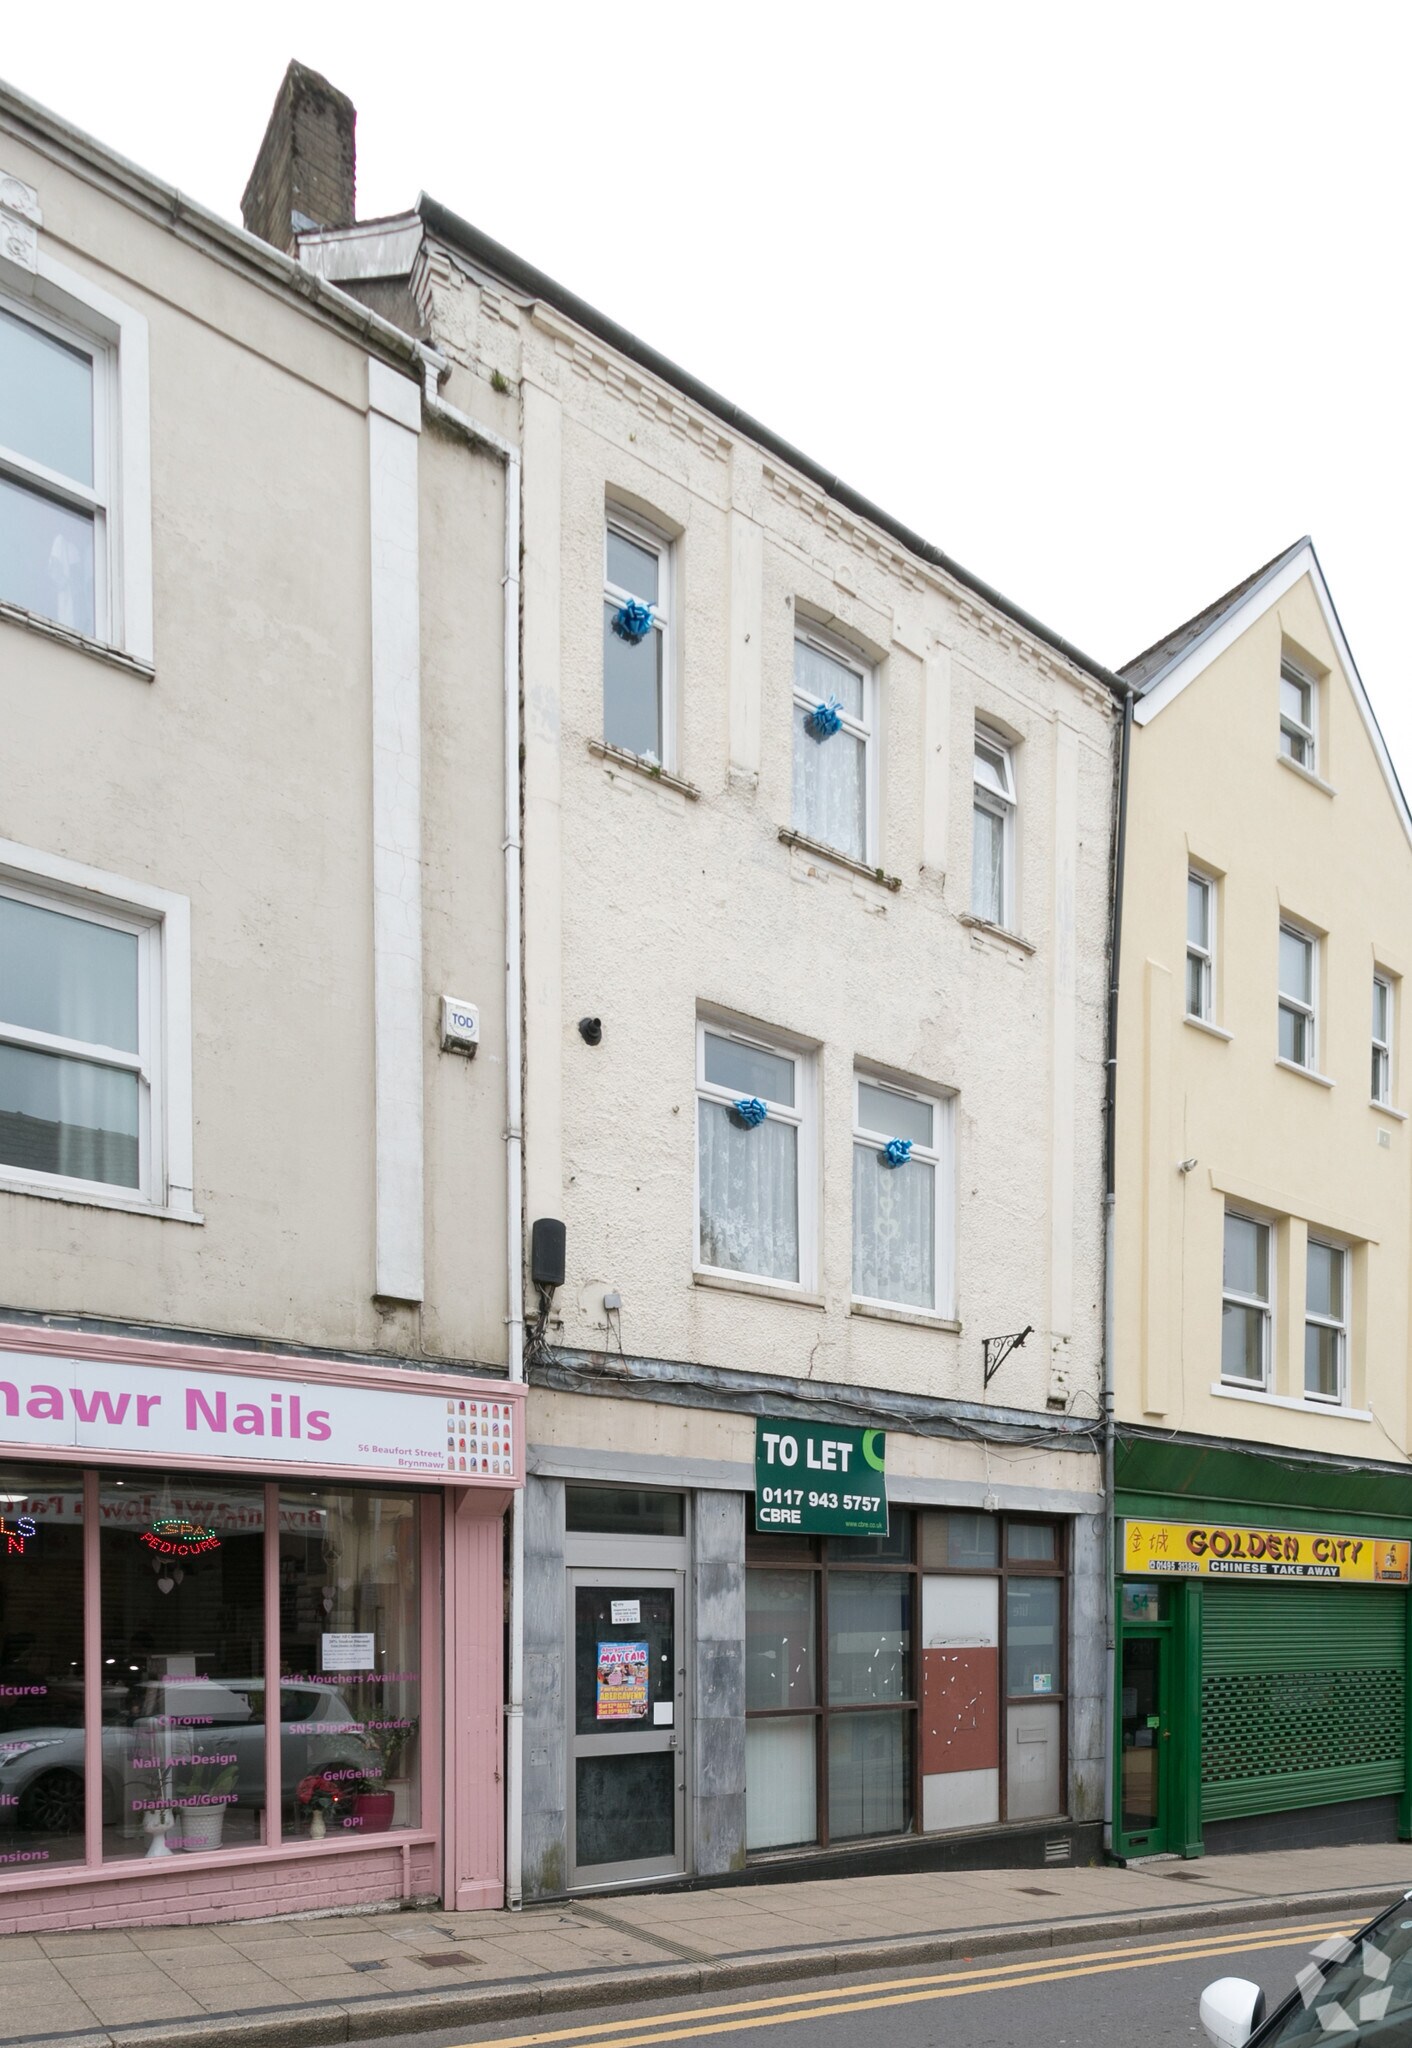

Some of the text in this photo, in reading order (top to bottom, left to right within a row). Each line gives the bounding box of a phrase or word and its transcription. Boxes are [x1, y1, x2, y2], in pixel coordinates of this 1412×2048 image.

[452, 1013, 474, 1029] TOD
[186, 1388, 332, 1442] Nails
[358, 1444, 444, 1459] 56 Beaufort Street,
[762, 1432, 854, 1472] TO LET
[398, 1458, 445, 1469] Brynmawr
[762, 1487, 880, 1512] 0117 943 5757
[760, 1508, 801, 1524] CBRE
[160, 1523, 206, 1536] SPA
[845, 1520, 883, 1529] www.cbre.co.uk
[140, 1532, 221, 1556] PEDICURE
[1186, 1530, 1364, 1565] GOLDEN CITY
[1211, 1561, 1338, 1577] CHINESE TAKE AWAY
[600, 1651, 646, 1663] MAY FAIR
[281, 1674, 305, 1686] Gift
[308, 1673, 364, 1684] Vouchers
[0, 1684, 48, 1696] icures
[158, 1715, 214, 1726] Chrome
[289, 1720, 412, 1735] SNS Dipping Powder
[132, 1753, 237, 1769] Nail Art Design
[323, 1768, 382, 1781] Gel/Gelish
[132, 1793, 239, 1811] Diamond/Gems
[343, 1816, 364, 1828] OPI
